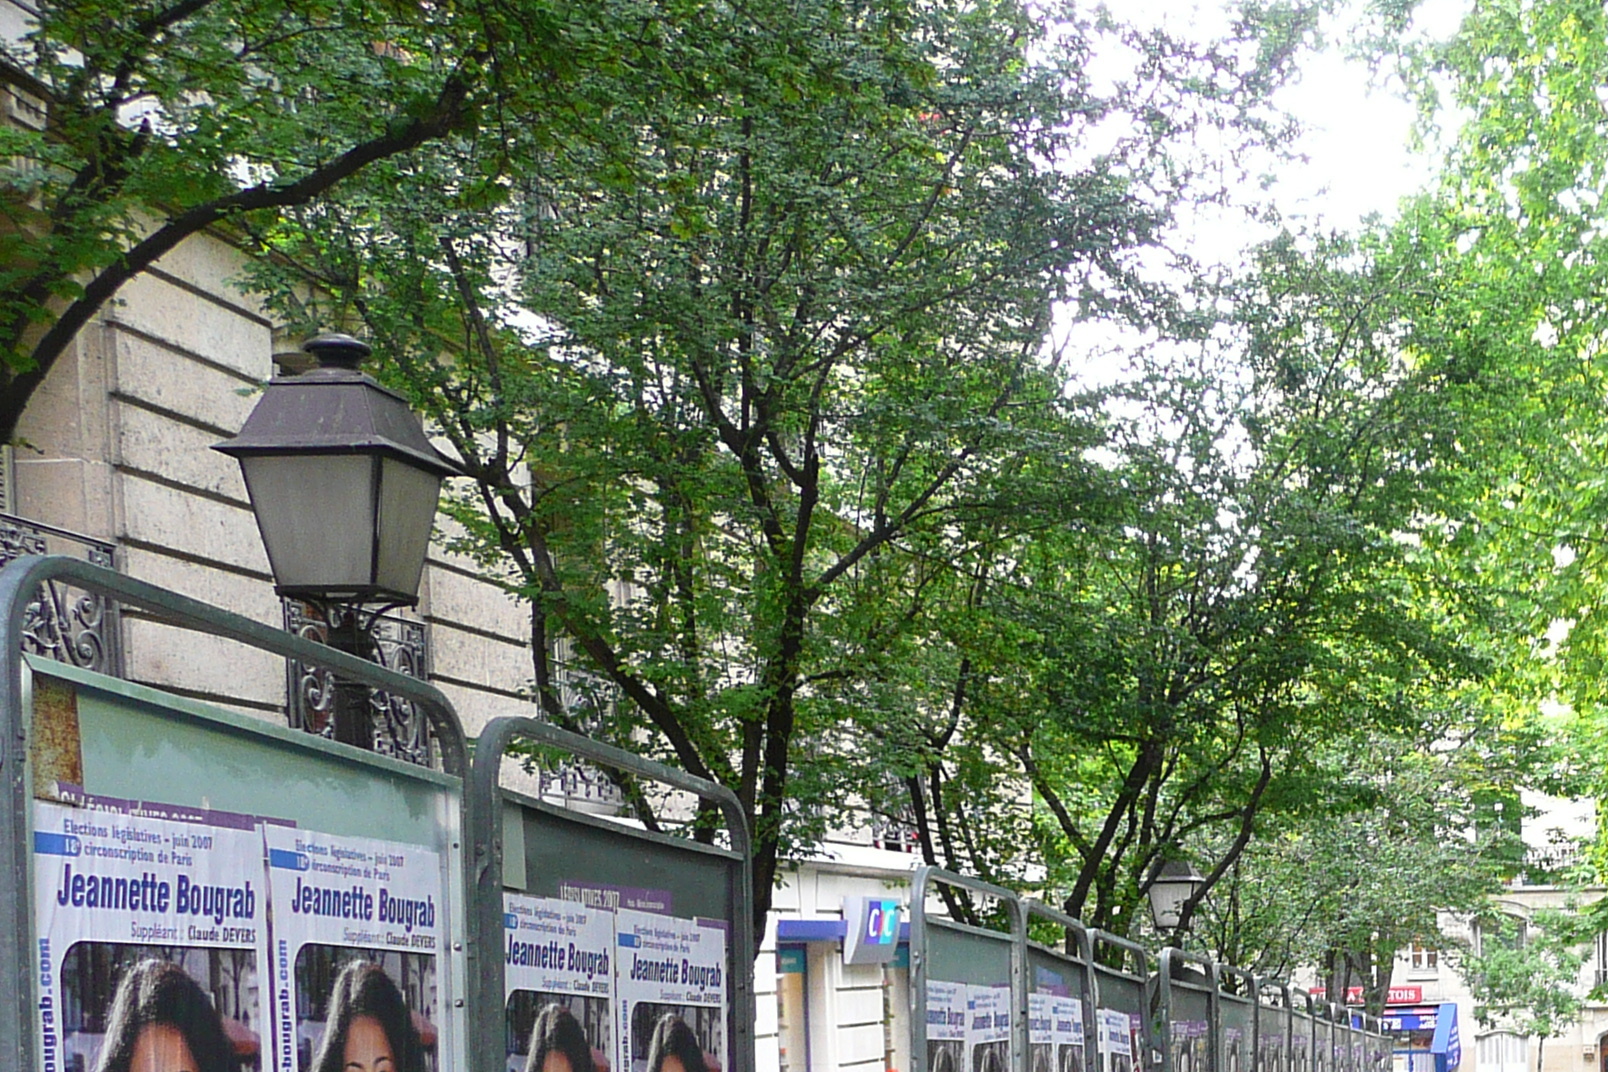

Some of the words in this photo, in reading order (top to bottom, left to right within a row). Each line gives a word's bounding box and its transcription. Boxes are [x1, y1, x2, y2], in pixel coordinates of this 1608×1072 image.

[84, 843, 154, 864] circonscription
[158, 850, 168, 860] de
[172, 850, 193, 866] Paris
[191, 835, 213, 850] 2007
[57, 863, 170, 913] Jeannette
[177, 874, 255, 925] Bougrab
[292, 877, 373, 921] Jeannette
[379, 888, 434, 933] Bougrab
[188, 926, 219, 941] Claude
[223, 927, 256, 943] DEVERS
[869, 909, 895, 936] CIC
[507, 934, 565, 970] Jeannette
[568, 943, 609, 980] Bougrab
[630, 953, 678, 984] Jeannette
[681, 959, 721, 991] Bougrab
